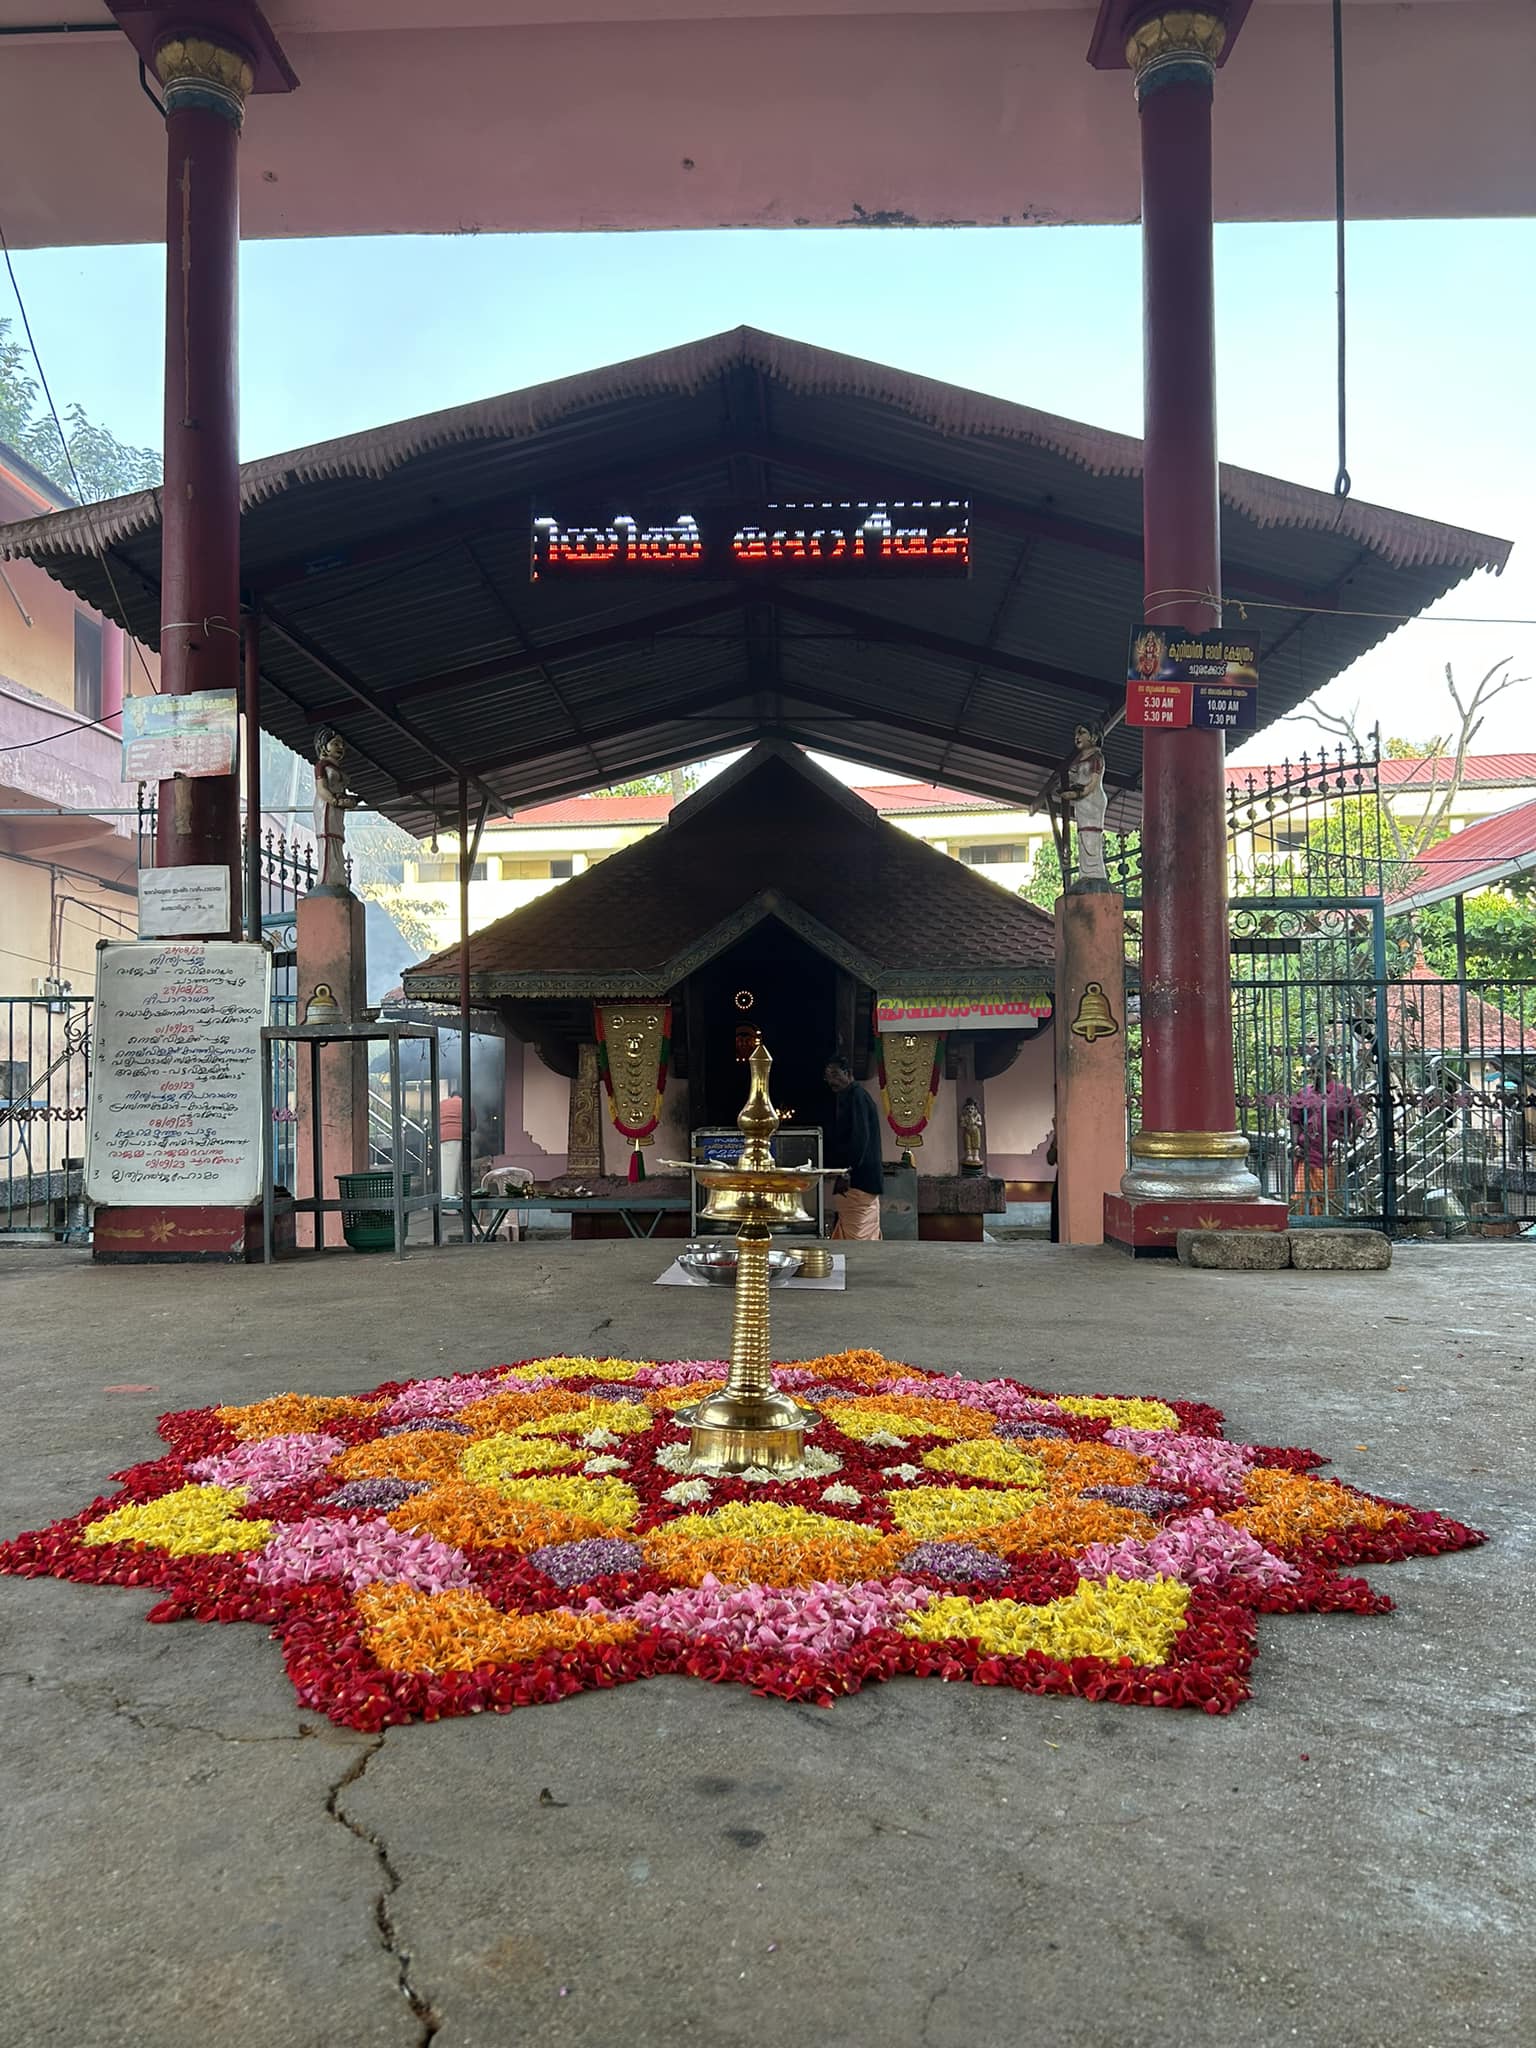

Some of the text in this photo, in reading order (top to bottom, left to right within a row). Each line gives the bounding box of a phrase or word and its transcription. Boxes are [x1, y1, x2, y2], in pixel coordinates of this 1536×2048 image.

[1144, 698, 1174, 709] 5.30 AM
[1207, 700, 1239, 711] 10.00 AM
[1144, 711, 1173, 722] 5.30 PM
[1208, 714, 1237, 725] 7.30 PM
[163, 985, 209, 995] 29/08/23
